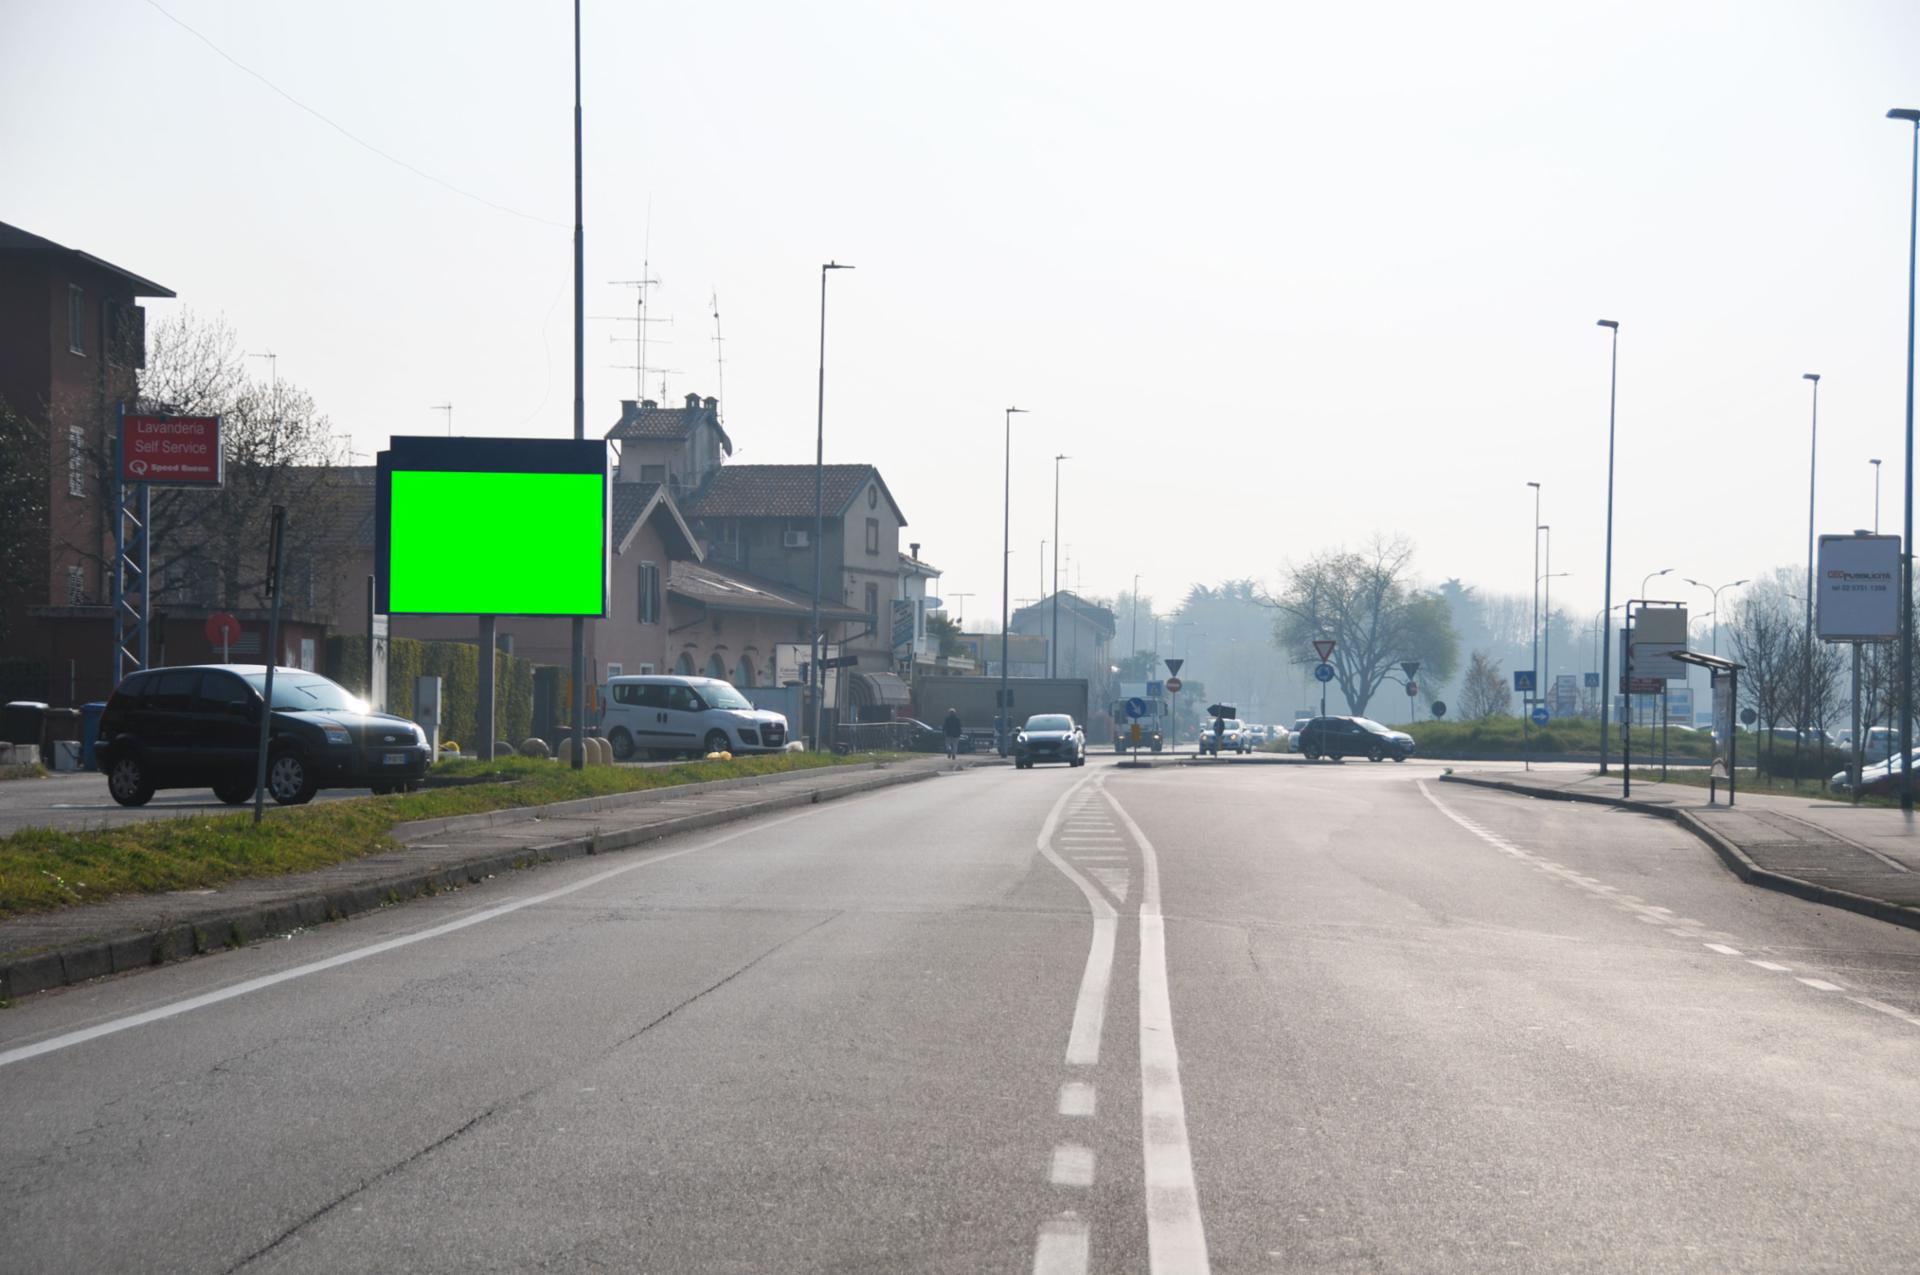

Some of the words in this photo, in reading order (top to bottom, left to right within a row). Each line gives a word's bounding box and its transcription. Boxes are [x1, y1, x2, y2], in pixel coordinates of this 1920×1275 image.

[137, 420, 204, 434] Lavanderia
[135, 439, 159, 453] Self
[162, 440, 207, 454] Service
